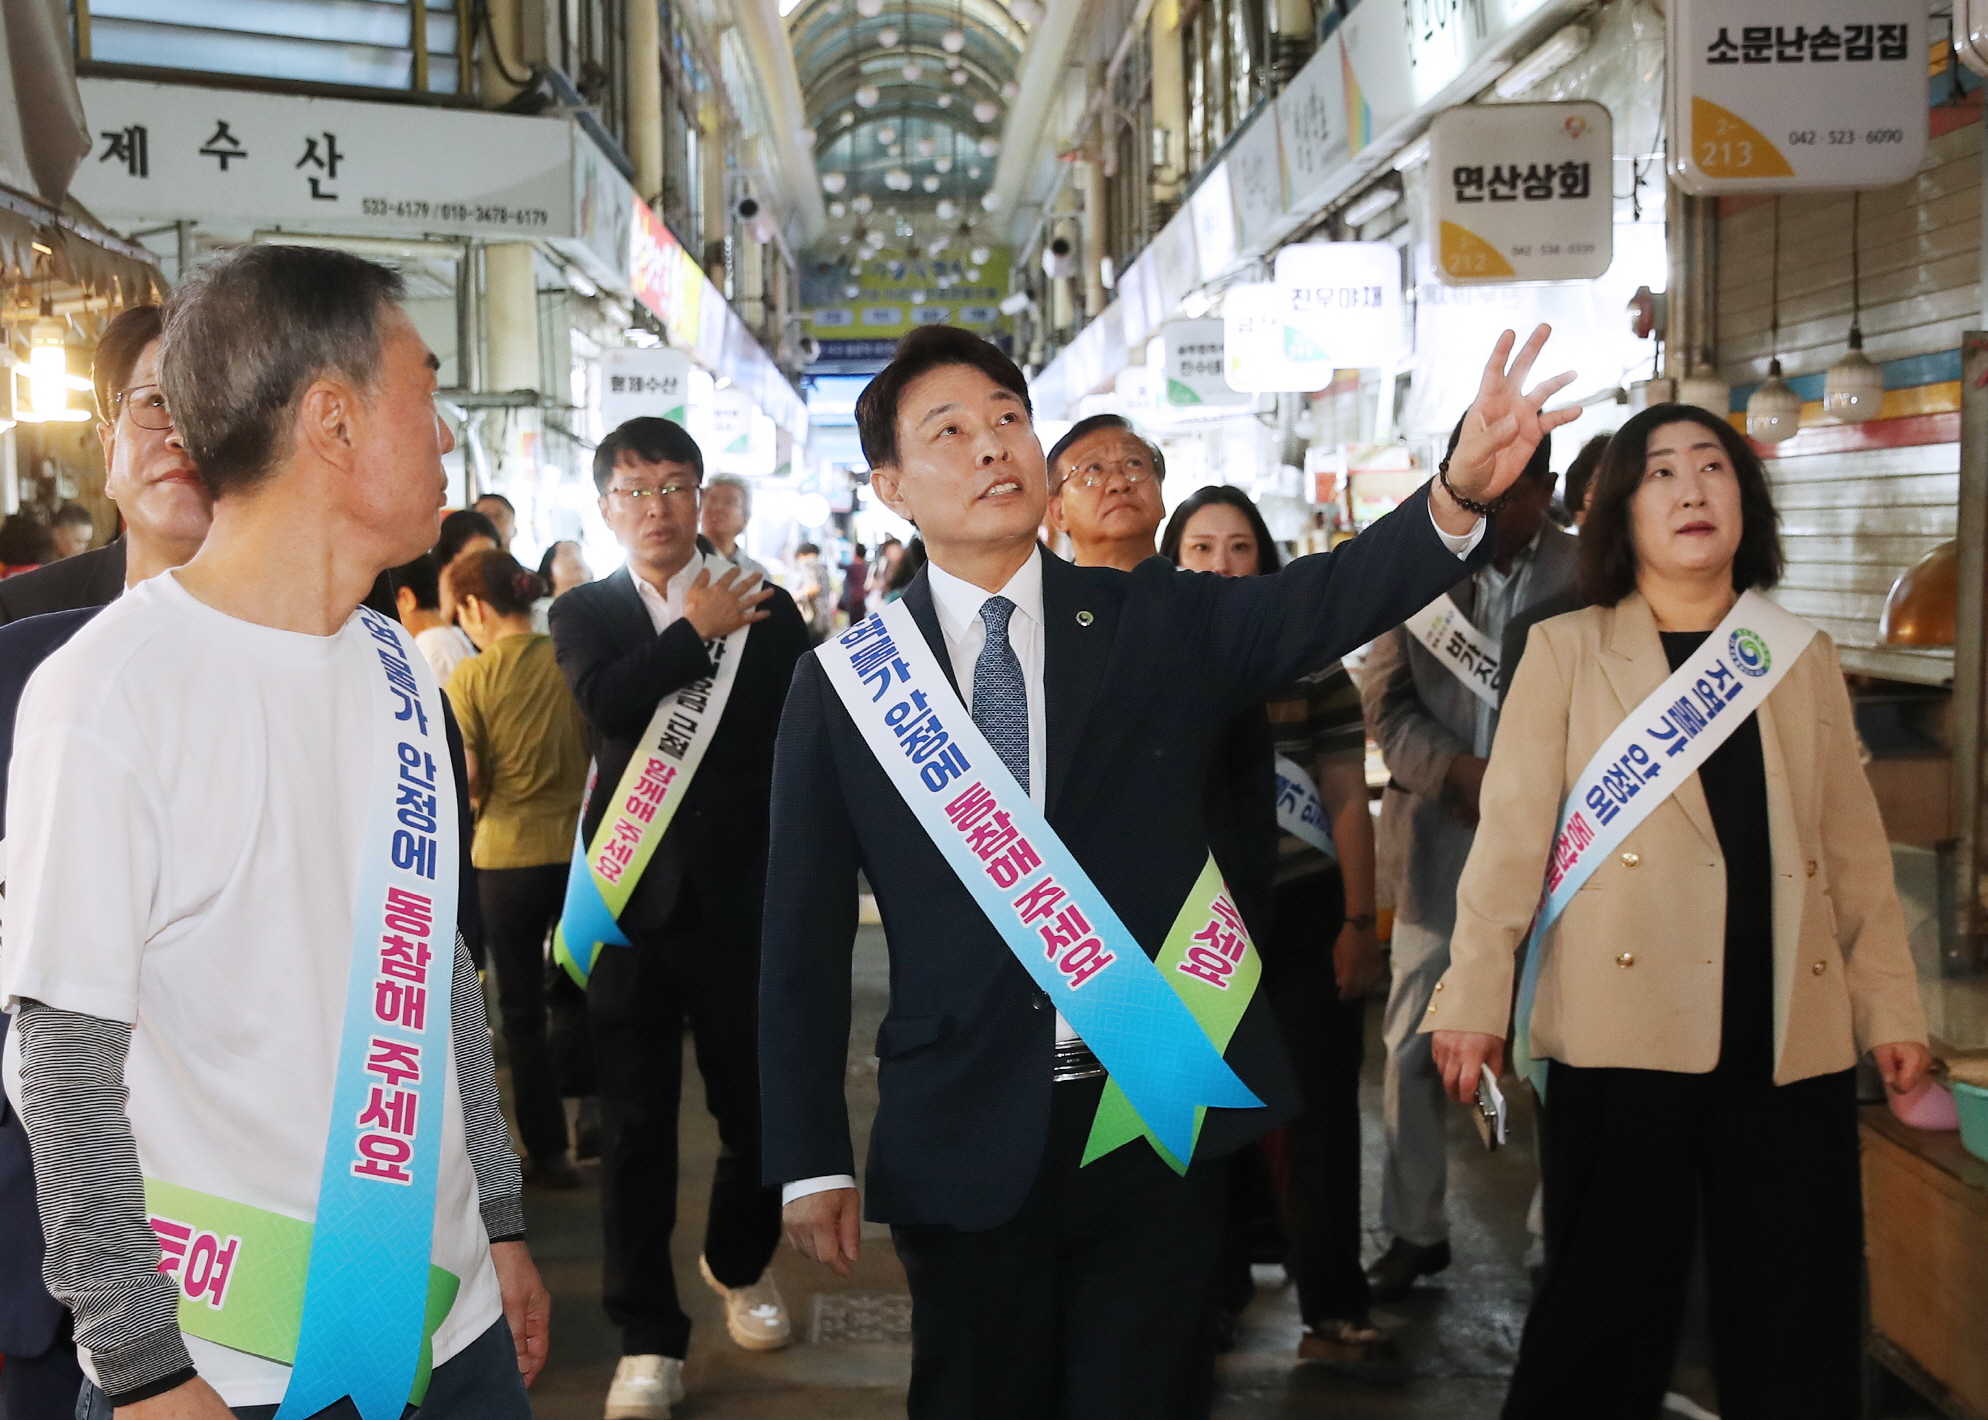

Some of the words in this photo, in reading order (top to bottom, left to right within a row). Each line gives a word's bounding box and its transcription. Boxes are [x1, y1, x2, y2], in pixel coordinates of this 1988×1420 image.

[1706, 23, 1909, 65] 소문난손김집
[1453, 161, 1591, 204] 연산상회
[1702, 142, 1753, 168] 213
[1293, 285, 1383, 312] 진우야채
[1646, 658, 1744, 758] 지역물가
[391, 741, 437, 881] 안정에
[625, 756, 678, 824] 함께해
[837, 612, 911, 704] 역물가
[884, 688, 972, 793] 안정에
[944, 781, 1043, 889] 동참해
[1013, 876, 1114, 988] 주세요
[1585, 743, 1662, 827] 안정에
[595, 817, 643, 885] 주세요
[371, 886, 433, 1032] 동참해
[354, 1038, 421, 1183] 주세요
